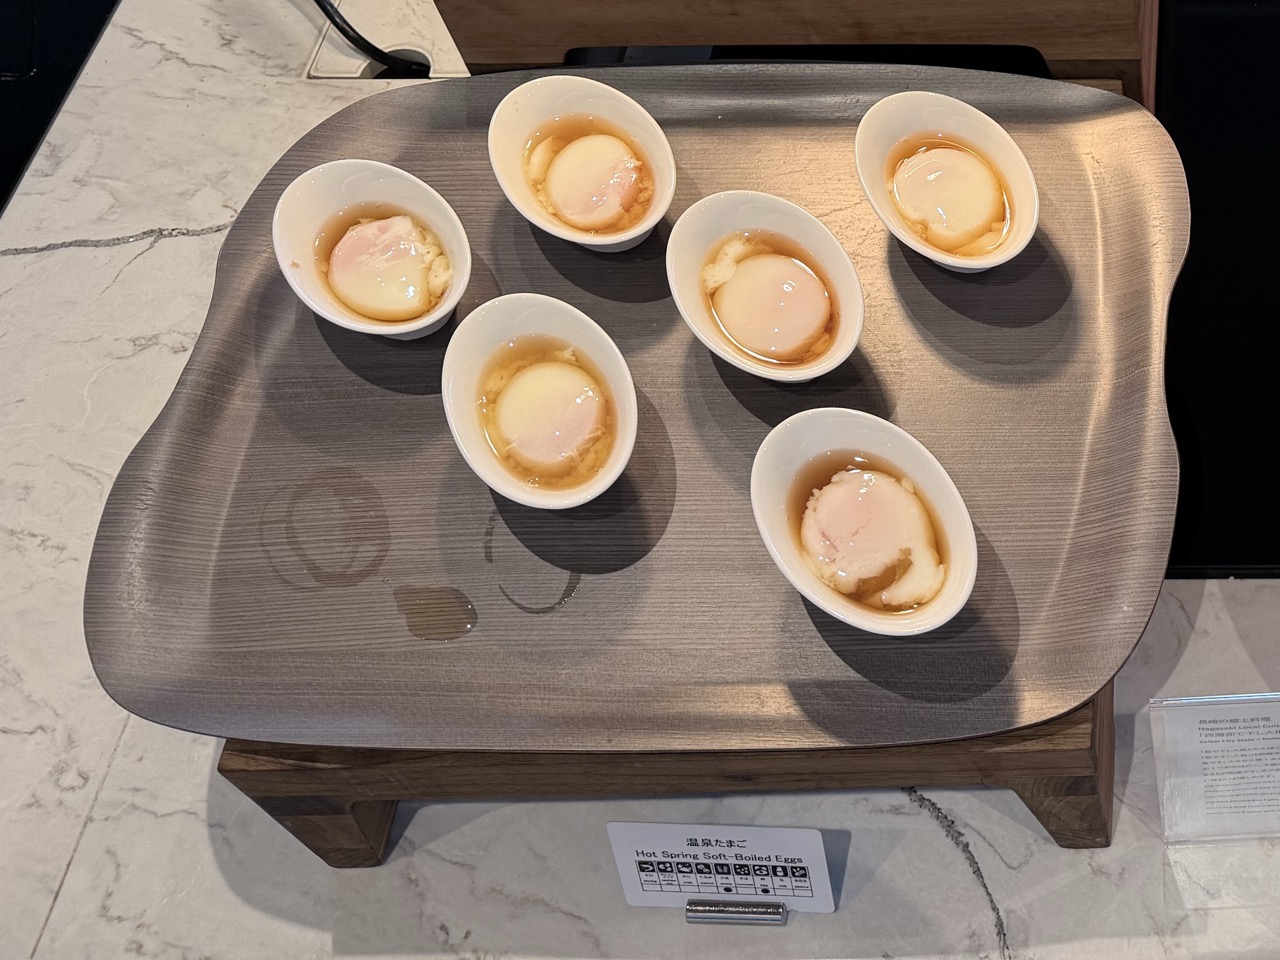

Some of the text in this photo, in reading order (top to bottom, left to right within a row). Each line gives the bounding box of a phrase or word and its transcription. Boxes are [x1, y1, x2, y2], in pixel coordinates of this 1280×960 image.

[686, 837, 747, 848] 温泉たまご
[661, 850, 698, 860] Spring
[703, 852, 770, 861] Soft-Boiled
[775, 855, 802, 864] Eggs
